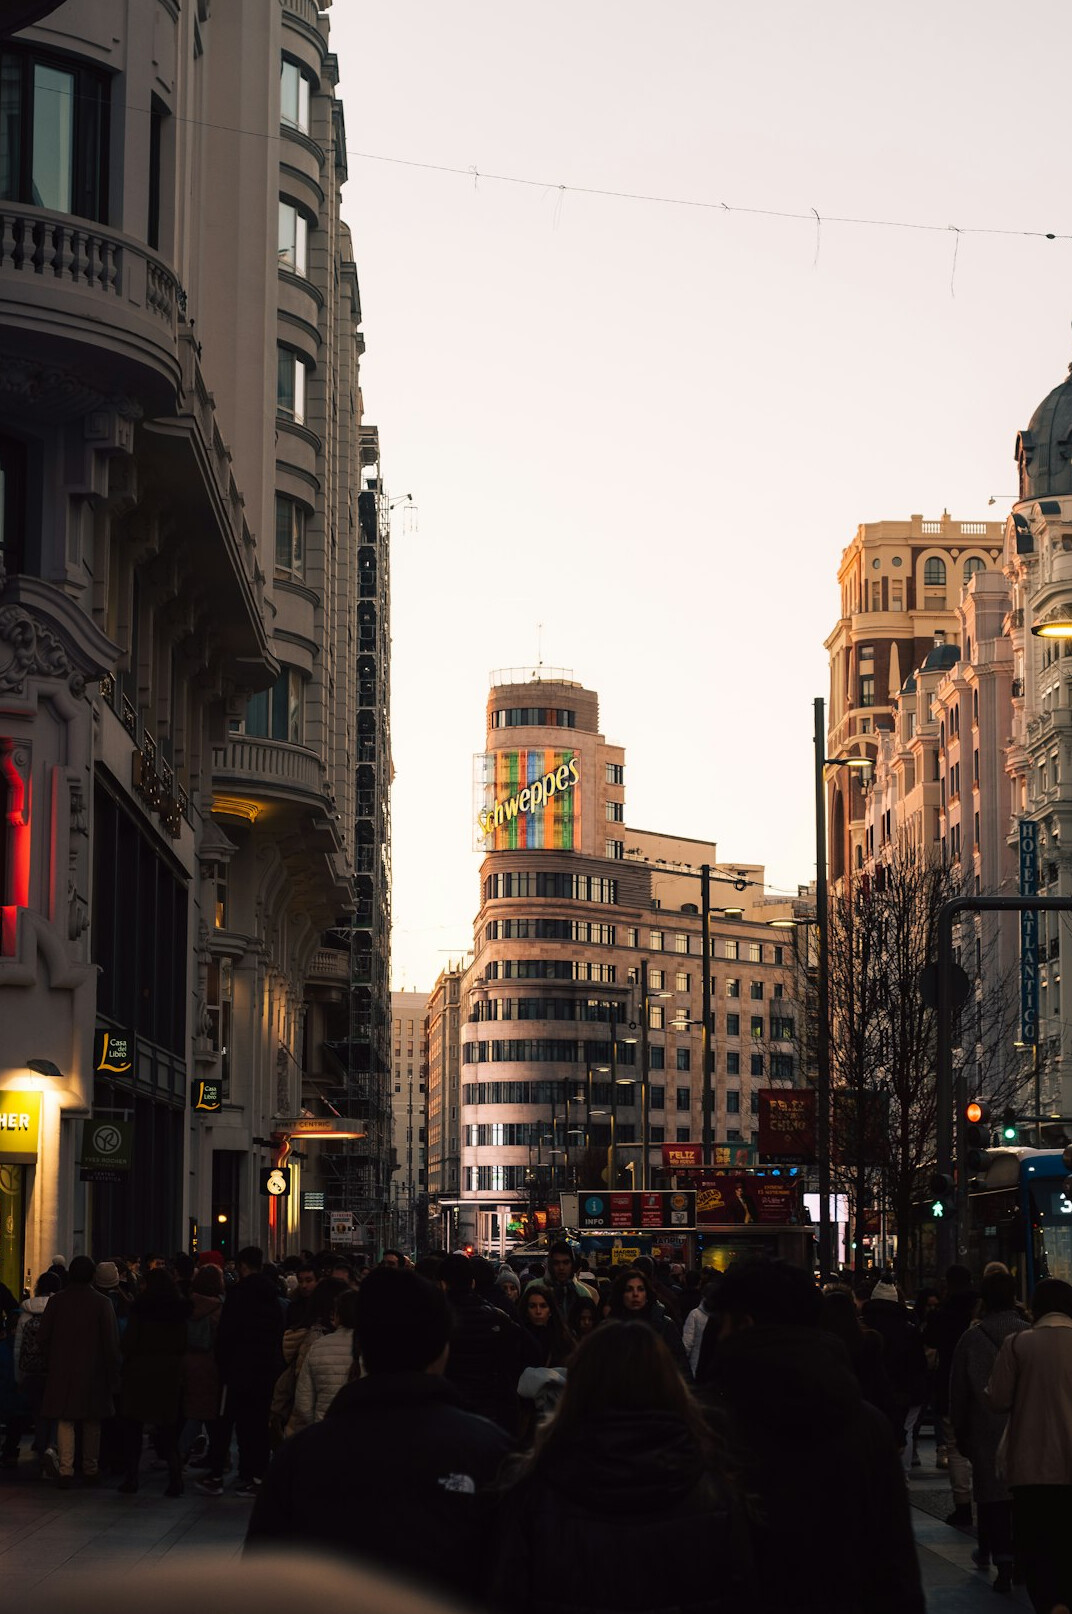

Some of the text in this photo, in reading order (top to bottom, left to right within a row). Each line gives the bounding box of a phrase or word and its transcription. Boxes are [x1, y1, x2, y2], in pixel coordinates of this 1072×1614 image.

[477, 758, 580, 844] Schweppes
[1021, 824, 1034, 896] HOTEL
[109, 1038, 127, 1047] Casa
[108, 1050, 127, 1058] Libro
[0, 1113, 30, 1128] HER
[669, 1151, 695, 1159] FELIZ
[584, 1218, 604, 1226] INFO
